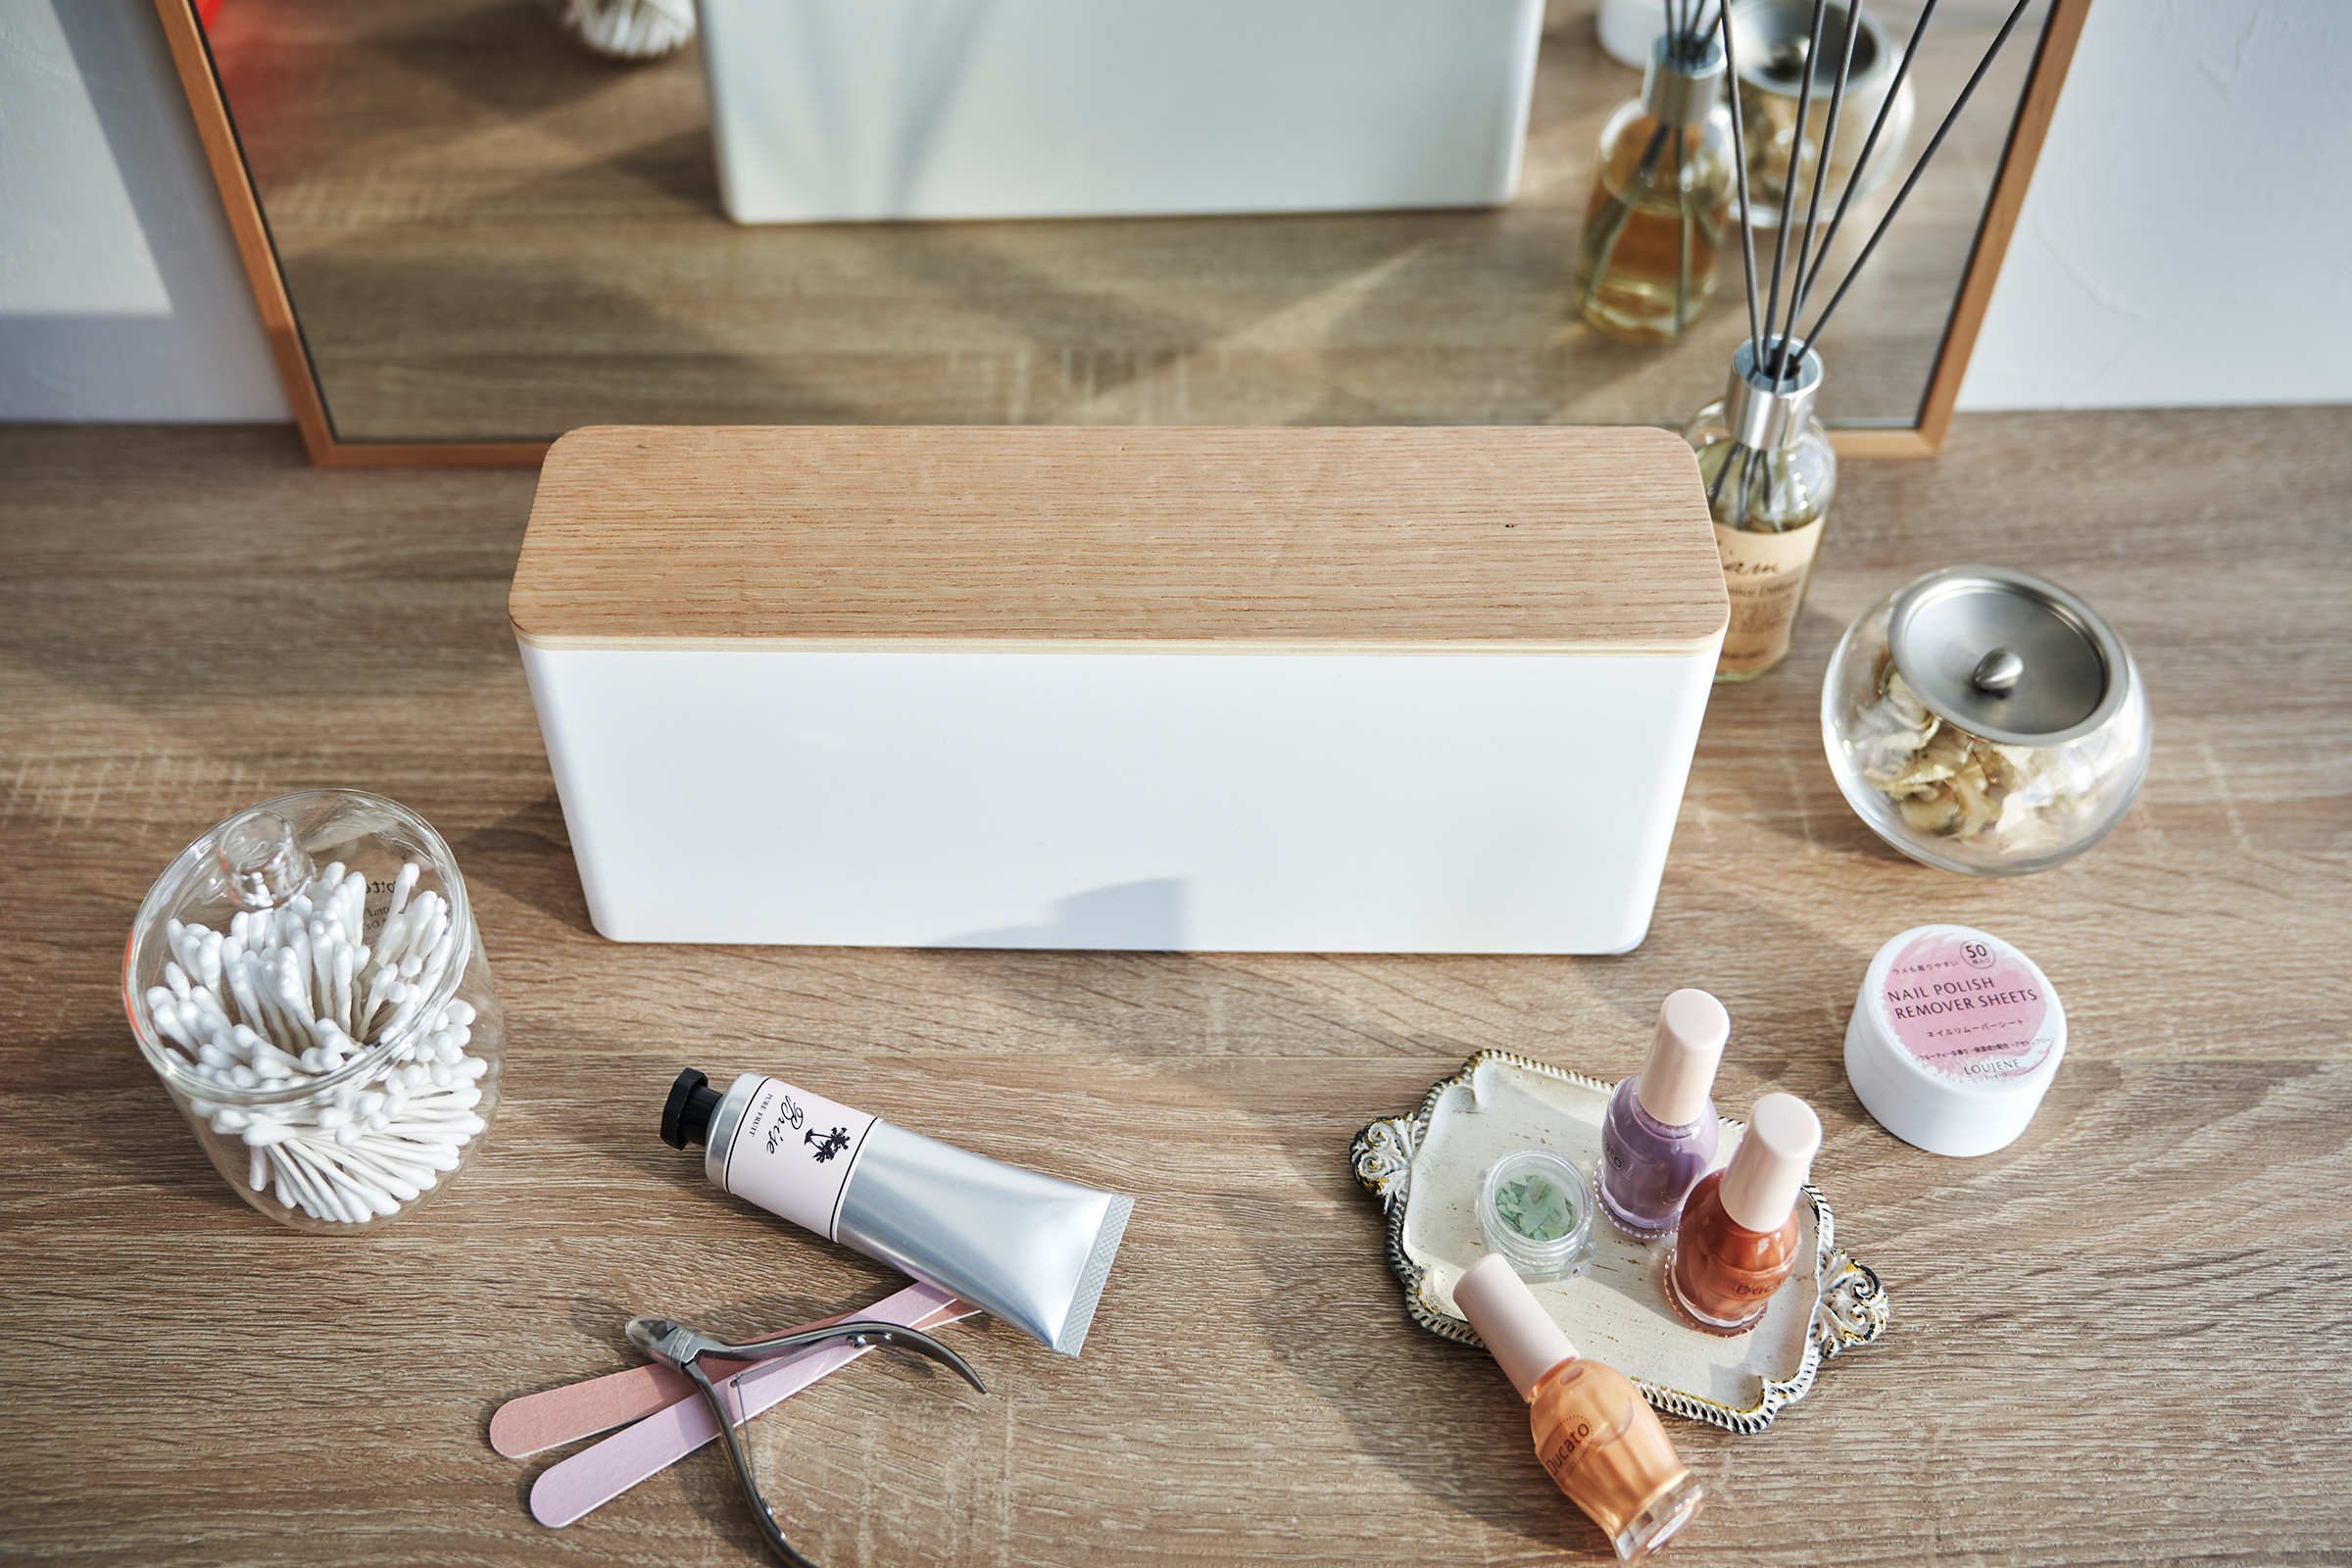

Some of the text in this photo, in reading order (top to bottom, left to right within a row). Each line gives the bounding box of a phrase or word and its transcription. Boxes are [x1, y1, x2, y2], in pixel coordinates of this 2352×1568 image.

[1965, 944, 1987, 958] 50
[1887, 977, 1994, 1003] NAIL POLISH
[1894, 989, 2037, 1020] REMOVER SHEETS
[749, 1093, 774, 1138] PURE FRUIT
[1604, 1140, 1622, 1168] ato
[1545, 1423, 1590, 1476] Ducato
